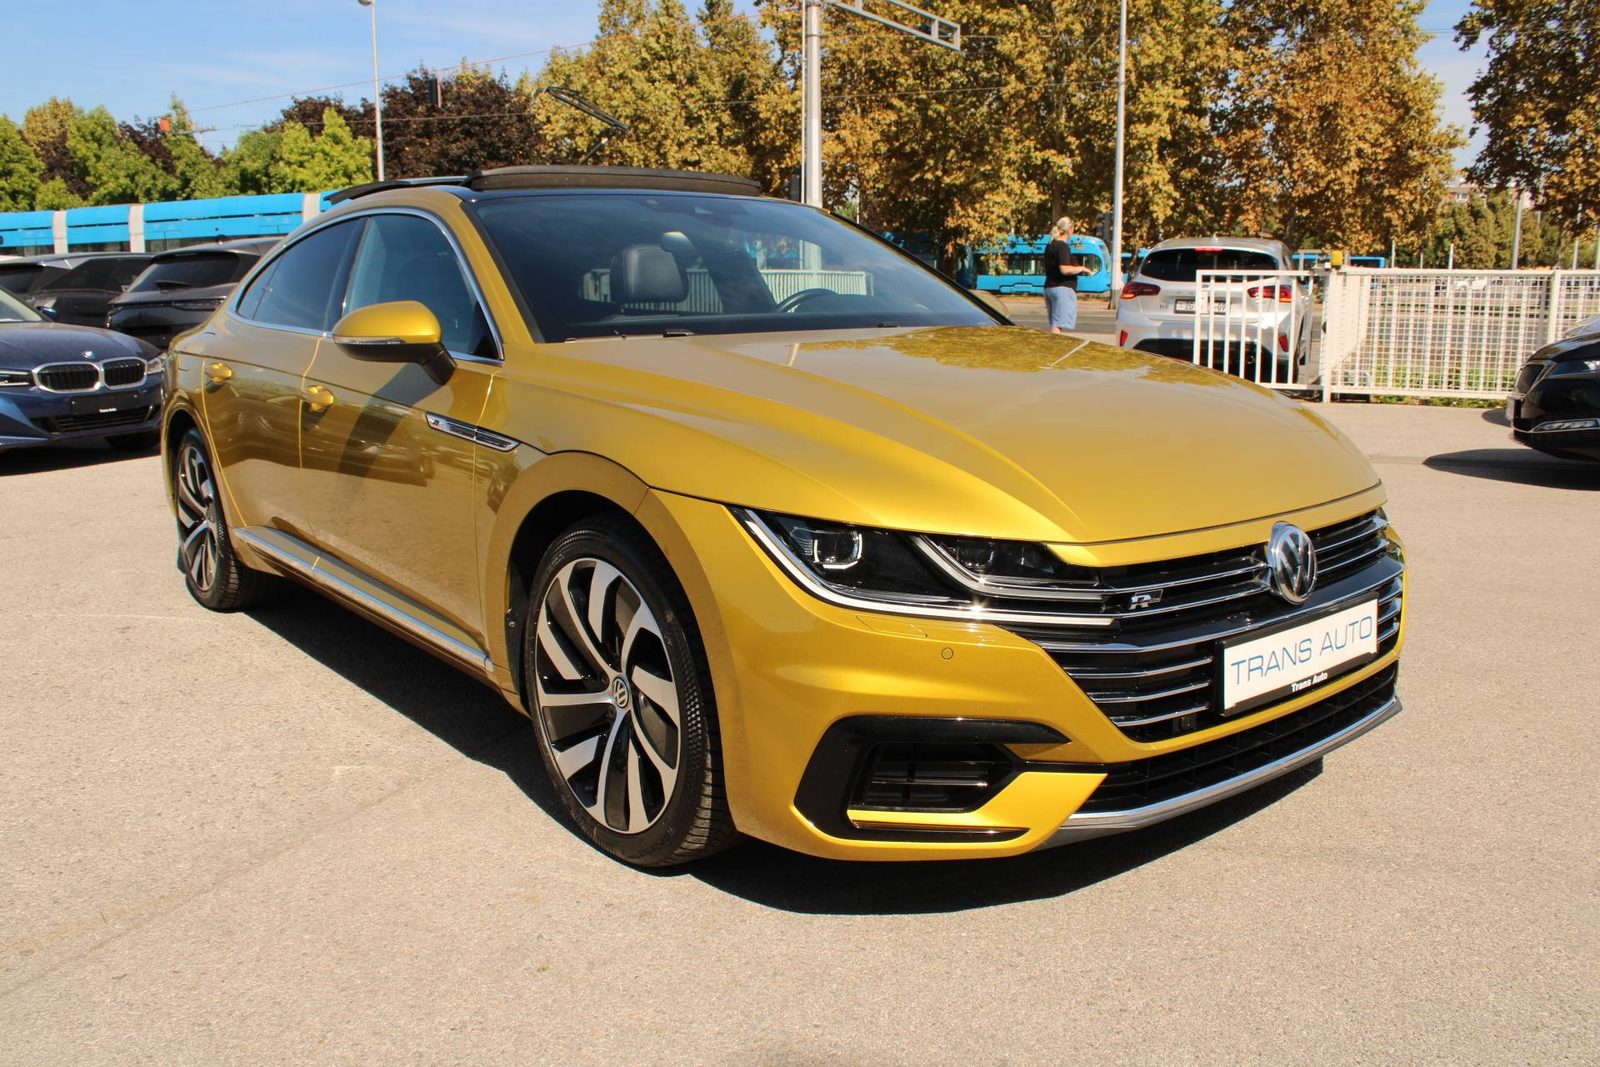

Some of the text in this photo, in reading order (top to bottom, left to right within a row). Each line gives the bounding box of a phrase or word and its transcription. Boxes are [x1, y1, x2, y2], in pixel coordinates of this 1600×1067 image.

[1129, 592, 1151, 610] R
[1230, 615, 1373, 685] TRANS AUTO
[1291, 672, 1328, 693] Trans Auto
